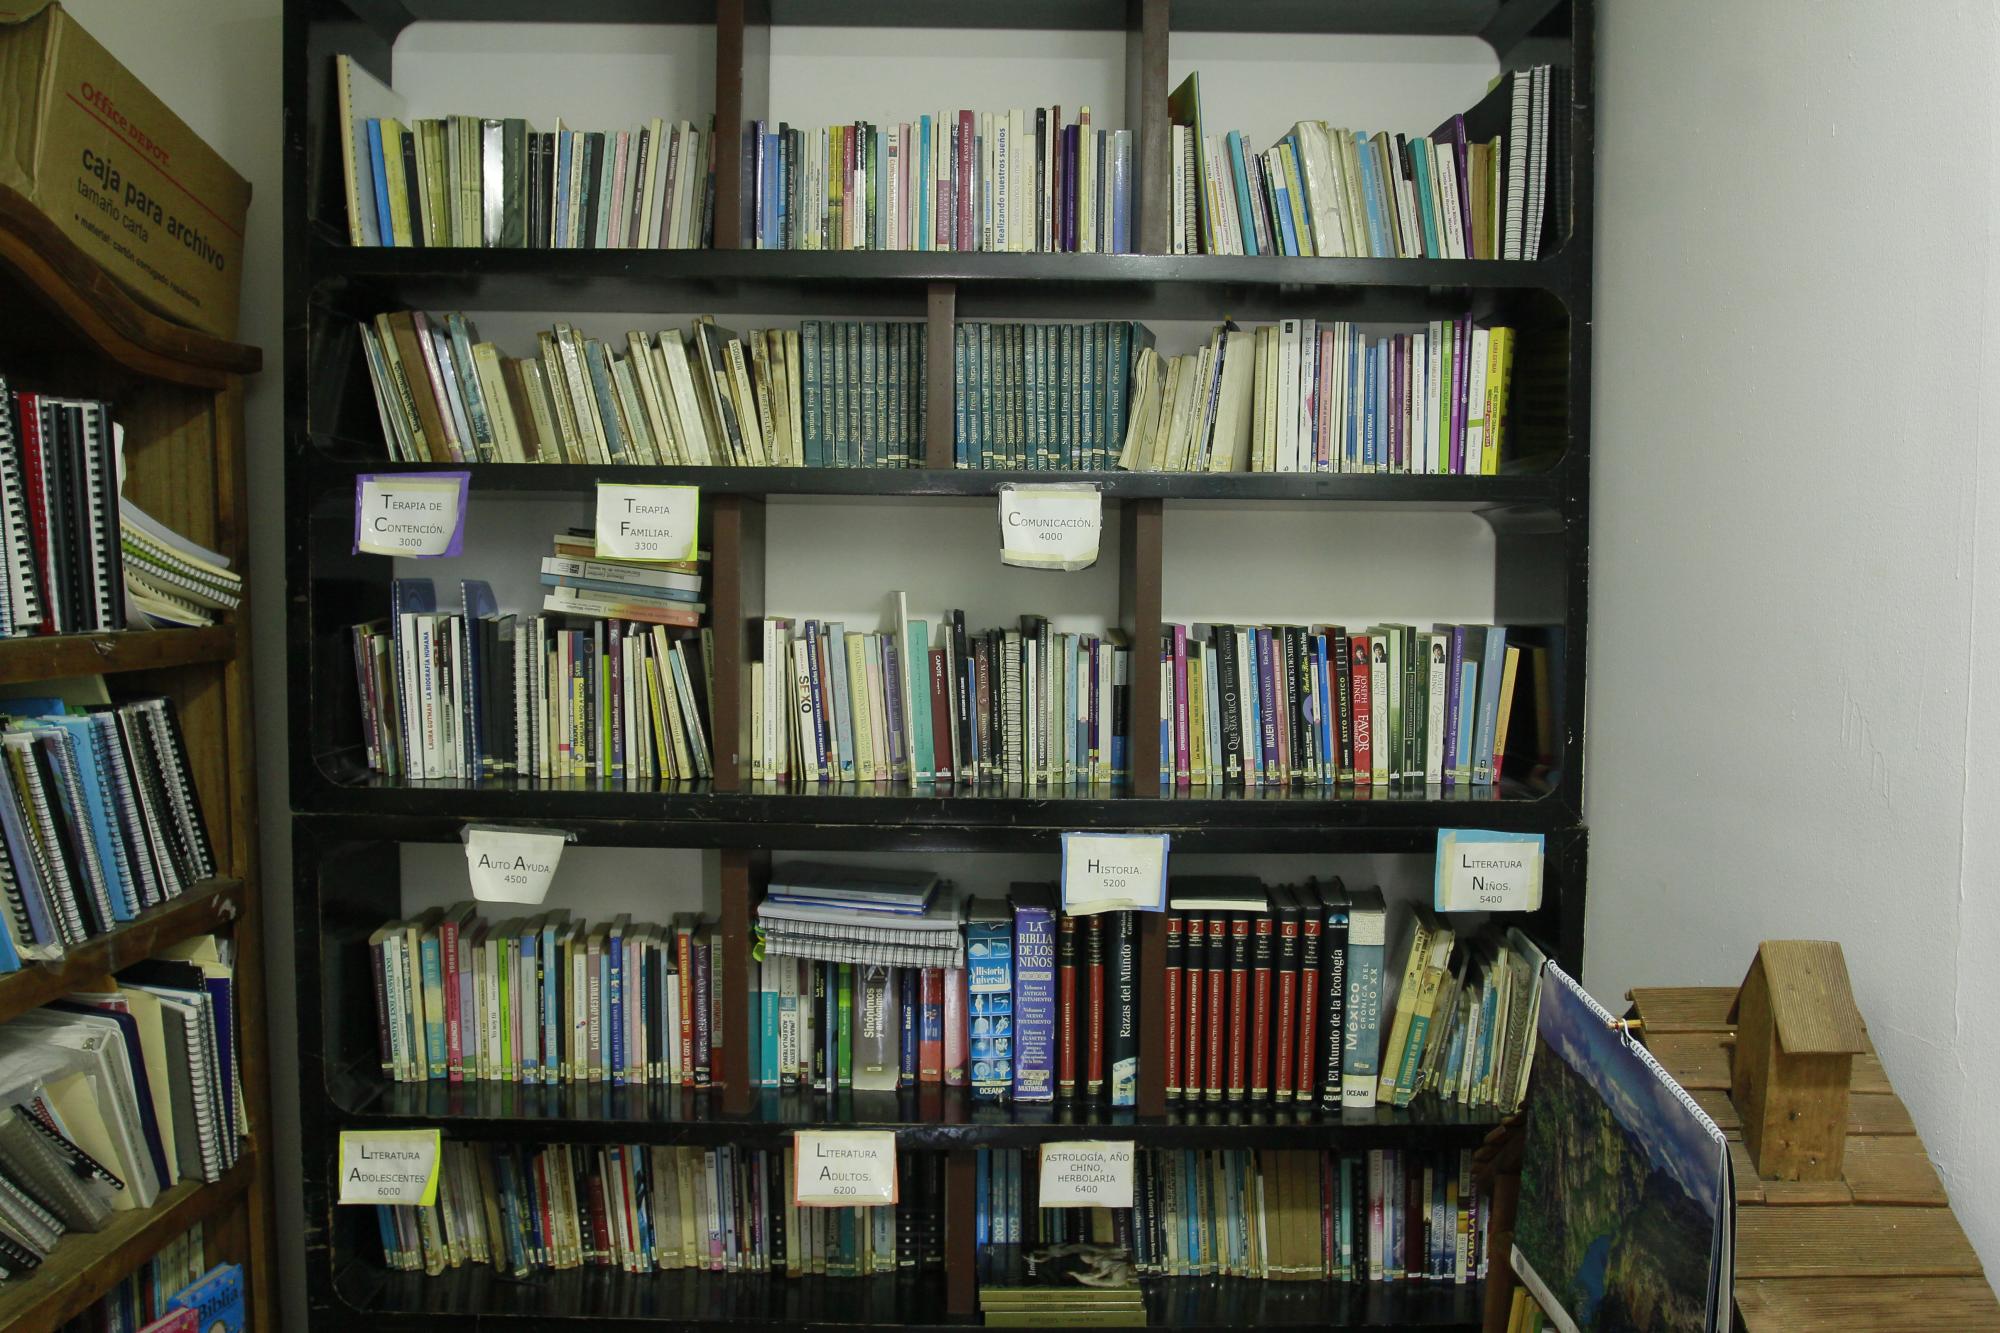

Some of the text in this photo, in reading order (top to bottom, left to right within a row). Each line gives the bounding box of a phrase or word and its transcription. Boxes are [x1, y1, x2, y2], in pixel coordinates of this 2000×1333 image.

[80, 82, 171, 168] Office DEPOT
[997, 128, 1006, 158] sueños
[77, 177, 149, 244] tamaño carta
[82, 149, 226, 272] caja para archivo
[997, 198, 1006, 244] Realizando
[981, 365, 989, 383] Obras
[982, 389, 990, 408] Freud
[983, 412, 991, 440] Sigmund
[399, 537, 422, 547] 3000
[1039, 532, 1063, 540] 4000
[635, 541, 658, 551] 3300
[1289, 658, 1294, 667] DE
[799, 675, 811, 713] SEXO
[1290, 694, 1296, 702] EL
[1339, 677, 1347, 717] CUÁNTICO
[1266, 724, 1274, 747] MUJER
[1358, 715, 1369, 753] FAVOR
[504, 875, 527, 884] 4500
[1103, 879, 1126, 887] 5200
[1479, 895, 1502, 903] 5400
[1028, 922, 1043, 933] LA
[1170, 921, 1177, 932] 1
[1191, 922, 1199, 932] 2
[1214, 924, 1221, 934] 3
[1236, 924, 1243, 933] 4
[1260, 923, 1267, 933] 5
[1285, 924, 1293, 935] 6
[1309, 924, 1316, 934] 7
[1019, 934, 1053, 944] BIBLIA
[1019, 945, 1053, 956] DE LOS
[1018, 956, 1052, 968] NIÑOS
[976, 966, 1004, 975] Historia
[713, 979, 721, 998] SALUD
[1120, 944, 1132, 1038] Razas del Mundo
[1368, 968, 1378, 1030] SIGLO XX
[864, 988, 875, 1038] Sinónimos
[874, 988, 882, 1031] antónimos
[1359, 985, 1368, 1029] CRÓNICA
[713, 1000, 721, 1032] HORMONAL
[1328, 949, 1344, 1081] El Mundo de la Ecología
[1345, 982, 1359, 1050] México
[1346, 1089, 1369, 1097] OCEANO
[1045, 1151, 1130, 1163] ASTROLOGÍA, AÑO
[1070, 1164, 1103, 1173] CHINO,
[377, 1185, 401, 1197] 6000
[832, 1184, 857, 1196] 6200
[1075, 1185, 1098, 1193] 6400
[995, 1217, 1005, 1242] 2012
[1010, 1217, 1019, 1242] 2012
[197, 1287, 240, 1321] Biblia
